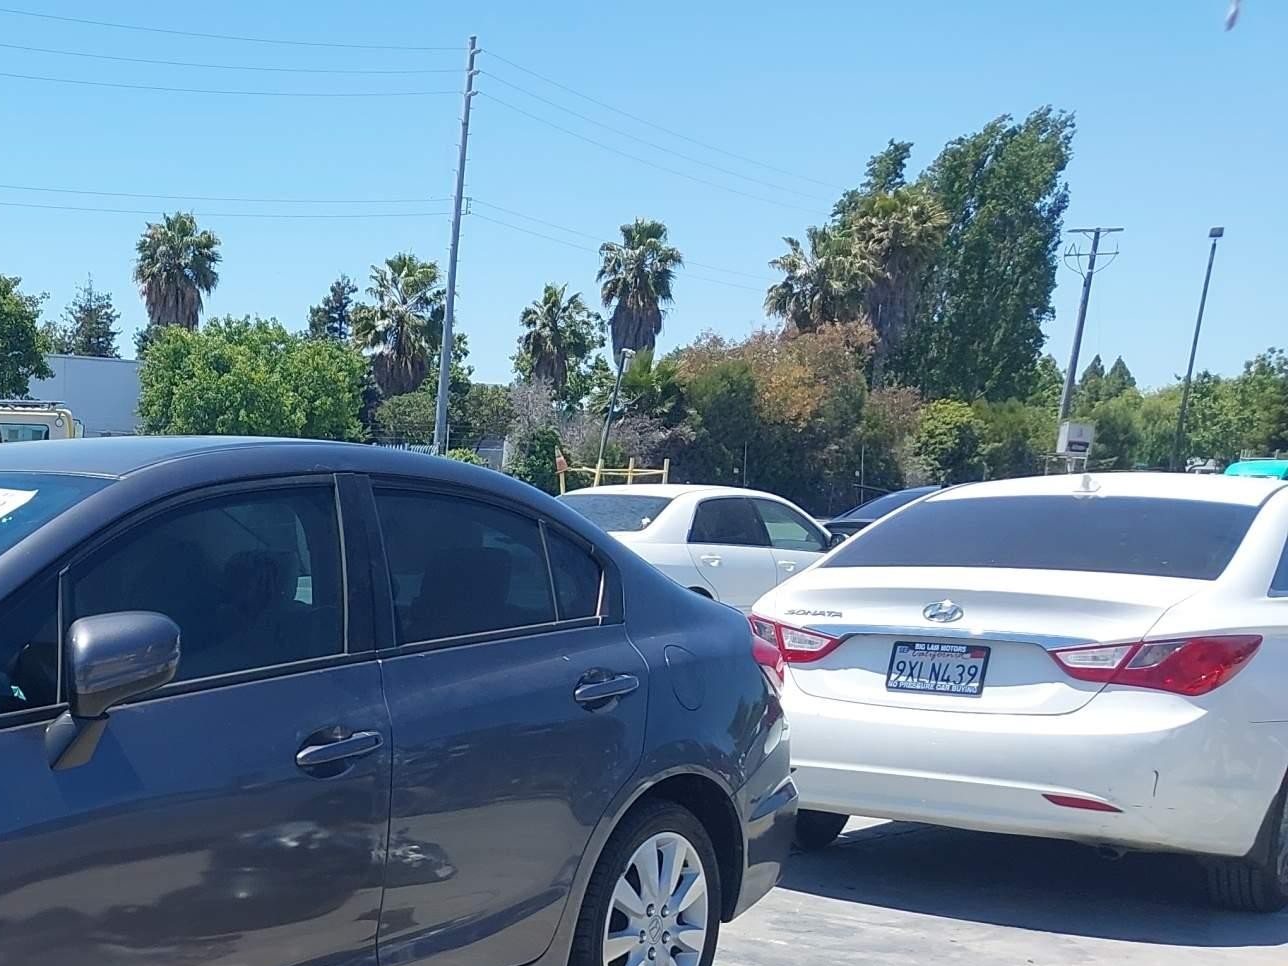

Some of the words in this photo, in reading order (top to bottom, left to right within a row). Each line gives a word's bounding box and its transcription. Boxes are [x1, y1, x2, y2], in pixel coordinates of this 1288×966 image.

[784, 609, 843, 618] SONATA
[941, 645, 967, 653] MOTORS
[895, 660, 979, 685] 9XLN439
[887, 680, 897, 688] NO
[899, 681, 934, 690] PRESSURE
[951, 685, 978, 693] BUYING
